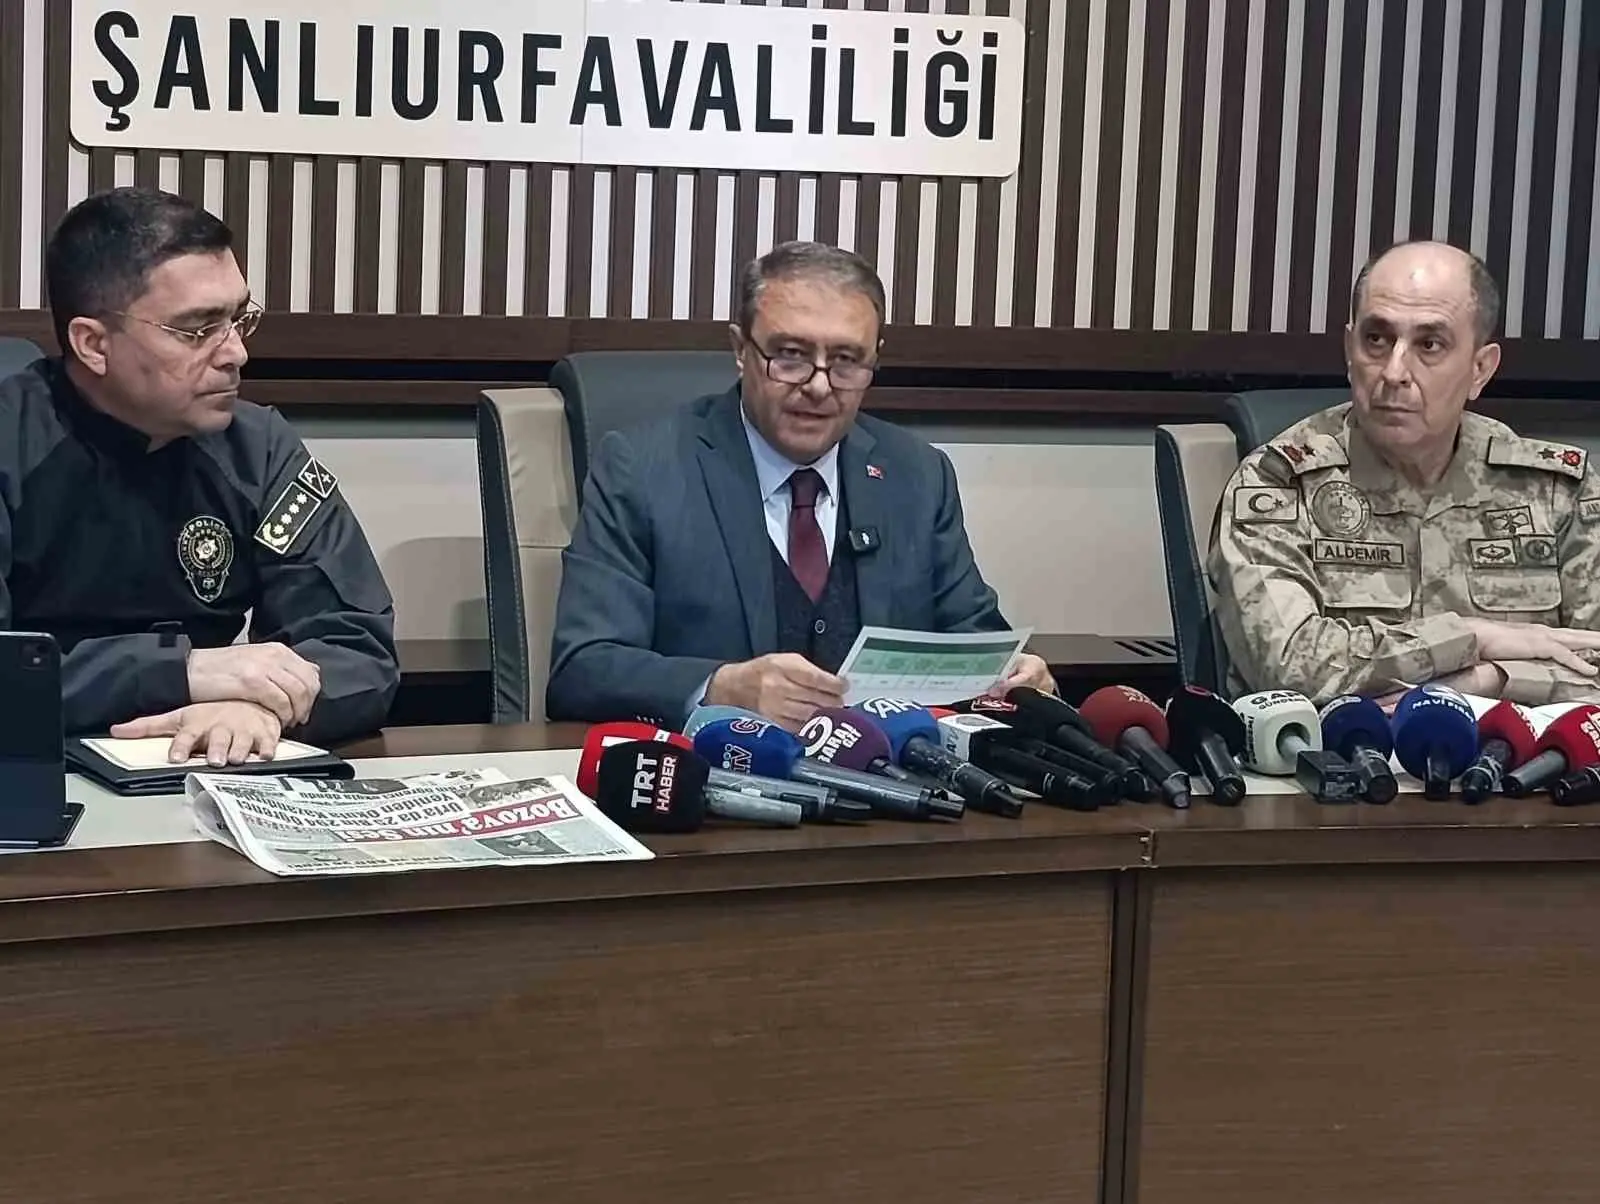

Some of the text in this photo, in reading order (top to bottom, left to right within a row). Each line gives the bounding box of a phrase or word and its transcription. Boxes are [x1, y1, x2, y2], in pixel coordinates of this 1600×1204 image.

[1324, 544, 1391, 562] ALDEMİR
[631, 752, 657, 808] TRT
[656, 756, 677, 811] HABER
[333, 798, 578, 842] Bozova'nın Sesi
